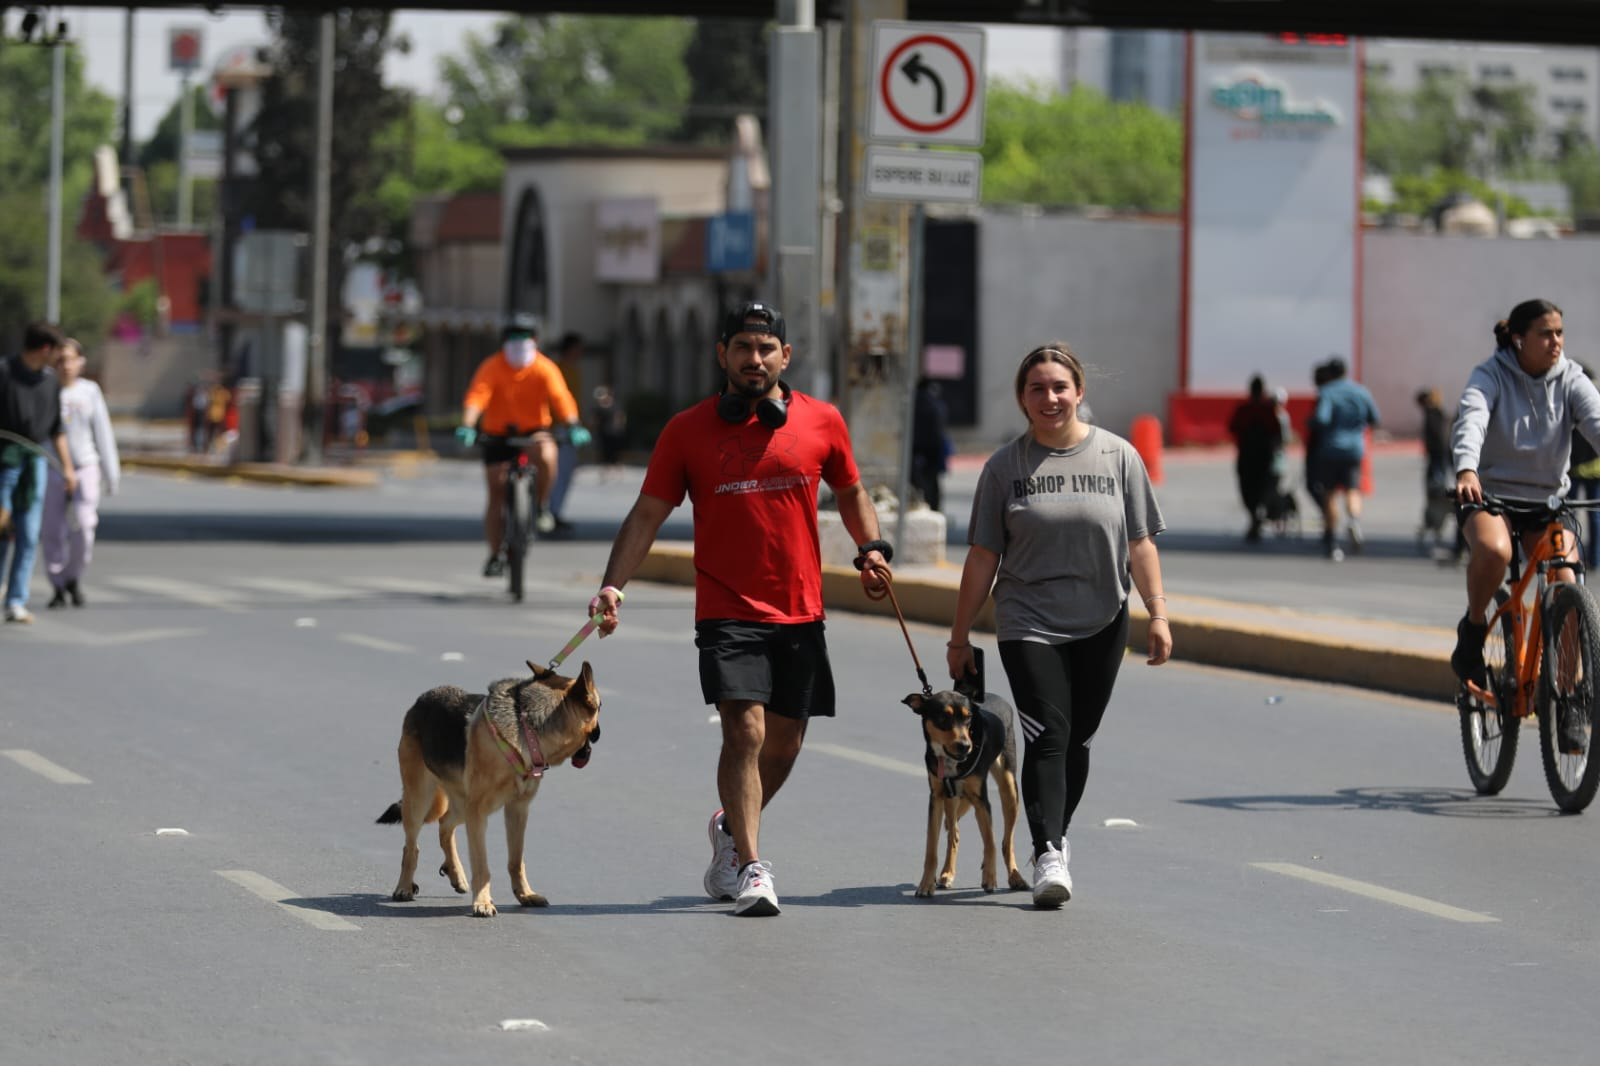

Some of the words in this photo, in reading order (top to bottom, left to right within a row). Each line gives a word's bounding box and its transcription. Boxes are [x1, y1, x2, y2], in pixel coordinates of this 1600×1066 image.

[715, 480, 758, 494] UNDER
[1014, 475, 1065, 498] BISHOP
[1072, 474, 1115, 496] LYNCH
